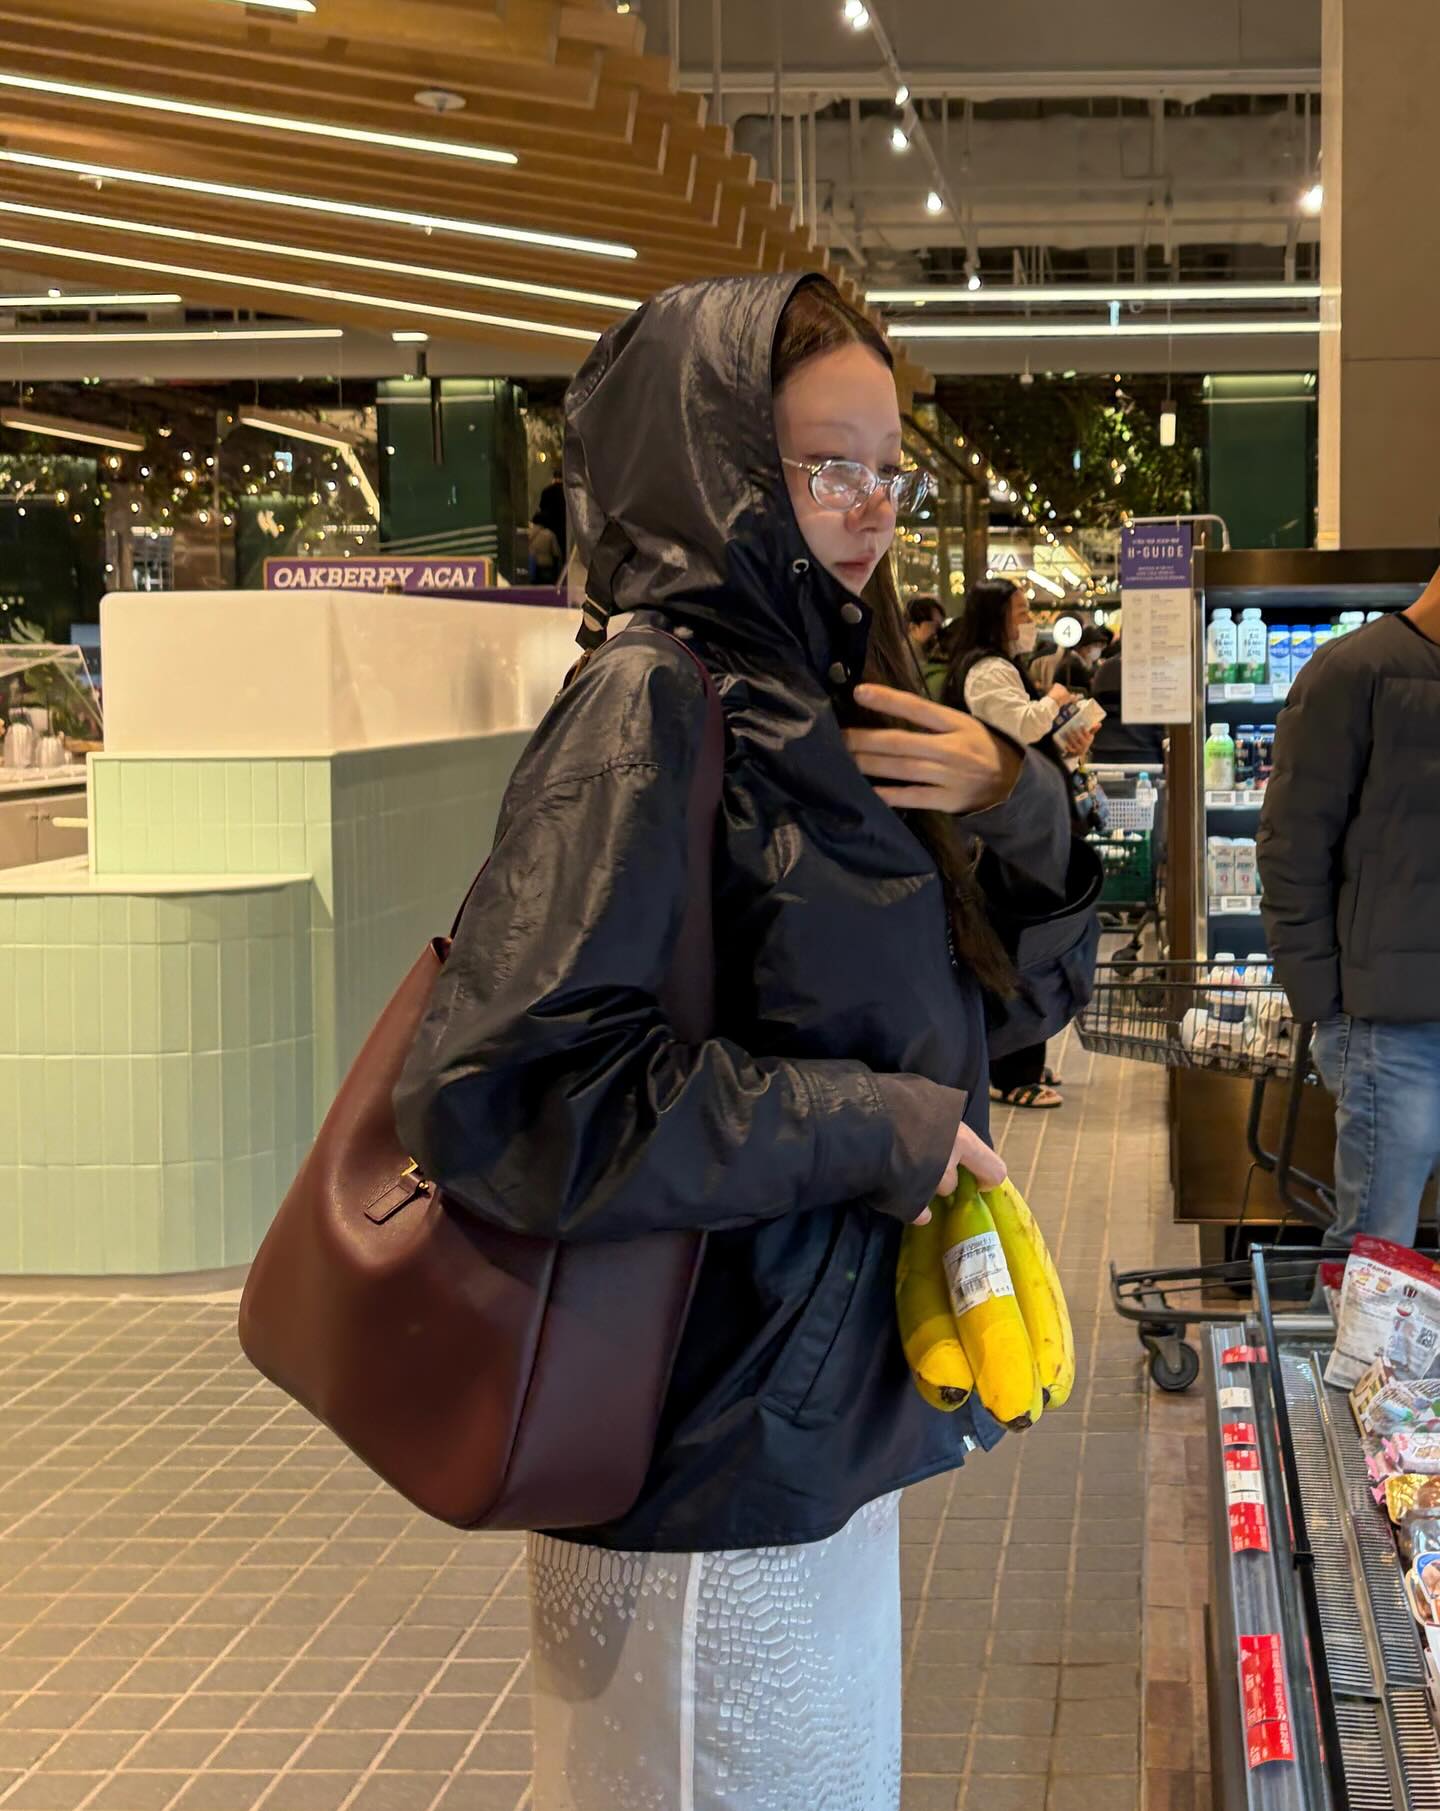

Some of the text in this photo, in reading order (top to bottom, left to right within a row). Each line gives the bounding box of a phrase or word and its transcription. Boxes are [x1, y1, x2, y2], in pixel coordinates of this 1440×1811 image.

[1128, 545, 1184, 559] H-GUIDE
[274, 567, 477, 588] OAKBERRY ACAI
